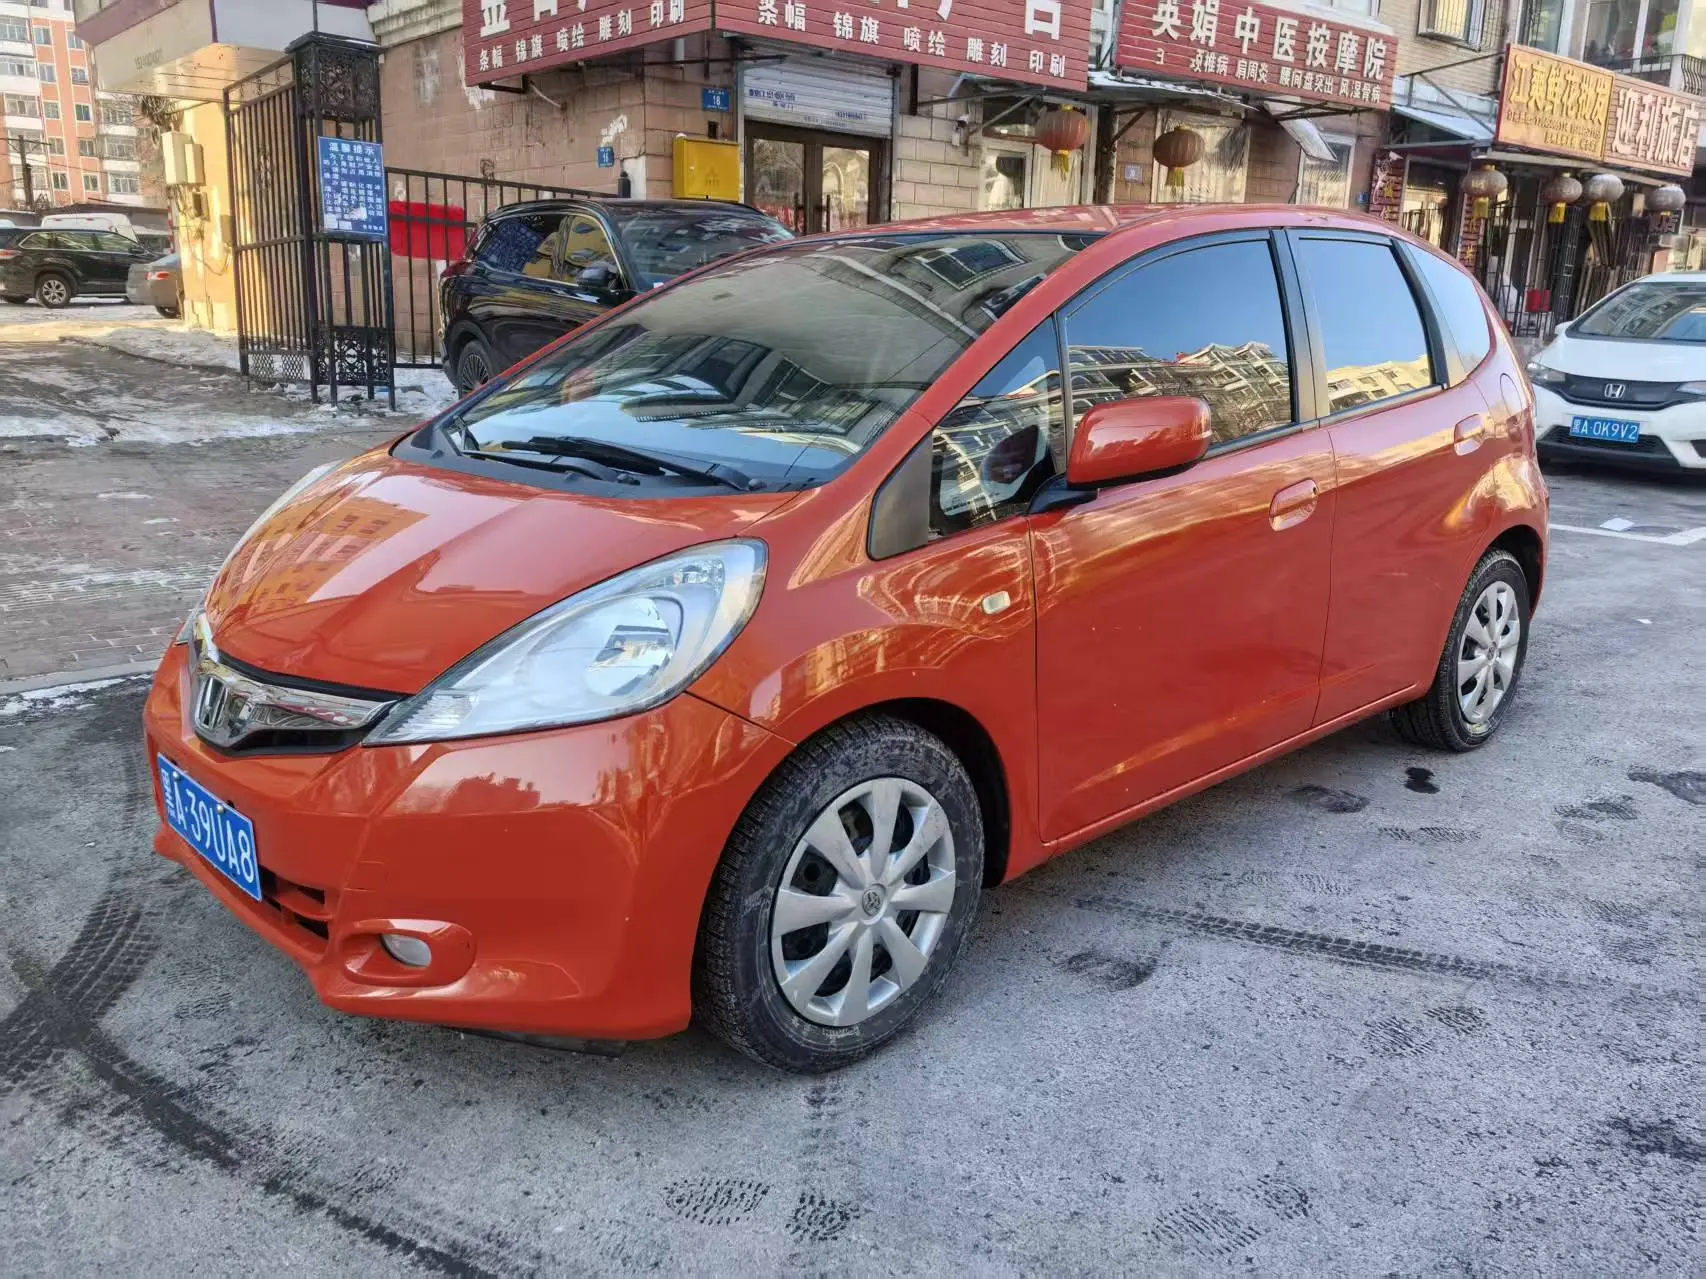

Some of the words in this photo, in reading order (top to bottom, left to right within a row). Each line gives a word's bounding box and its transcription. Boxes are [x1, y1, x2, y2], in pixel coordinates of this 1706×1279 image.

[479, 45, 503, 71] 条幅
[516, 34, 543, 63] 锦旗
[557, 22, 585, 51] 喷绘
[599, 9, 632, 41] 雕刻
[650, 0, 685, 28] 印刷
[758, 0, 807, 32] 条幅
[833, 11, 880, 45] 锦旗
[904, 26, 946, 57] 喷绘
[967, 37, 1008, 67] 雕刻
[1029, 50, 1066, 78] 印刷
[1152, 0, 1387, 81] 英娟中医按摩院
[1235, 59, 1269, 83] 肩周炎
[1279, 66, 1334, 95] 腰间盘突出
[1339, 77, 1382, 103] 风湿骨病
[329, 142, 374, 156] 温馨提示
